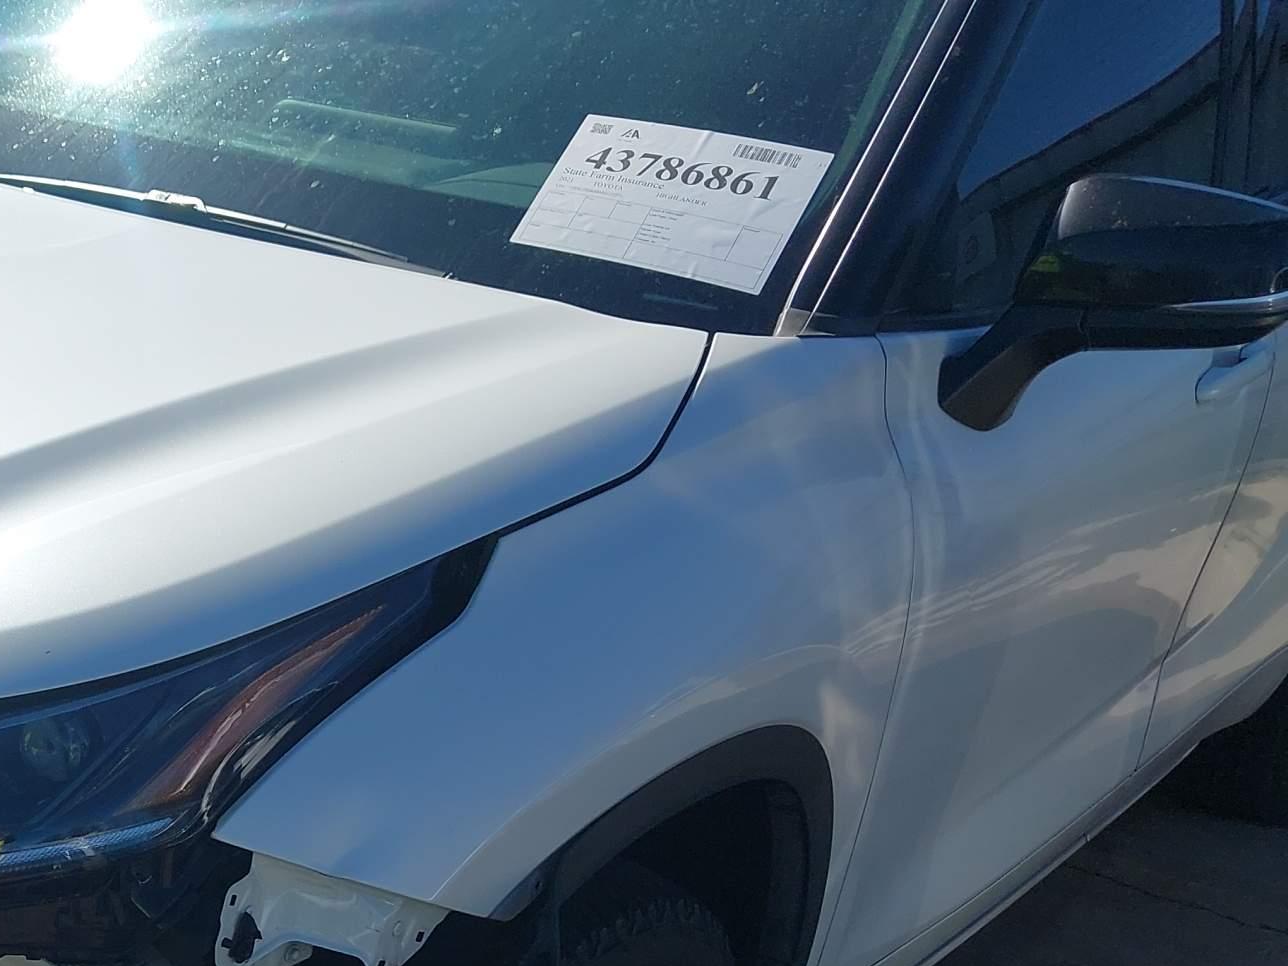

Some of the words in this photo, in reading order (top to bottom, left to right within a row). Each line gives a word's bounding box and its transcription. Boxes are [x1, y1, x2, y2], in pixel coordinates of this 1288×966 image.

[562, 167, 588, 177] State
[589, 170, 615, 181] Farm
[616, 174, 665, 190] Insurance
[585, 146, 780, 201] 43786861
[593, 181, 624, 192] TOYOTA
[655, 192, 708, 207] HIGHLANDER
